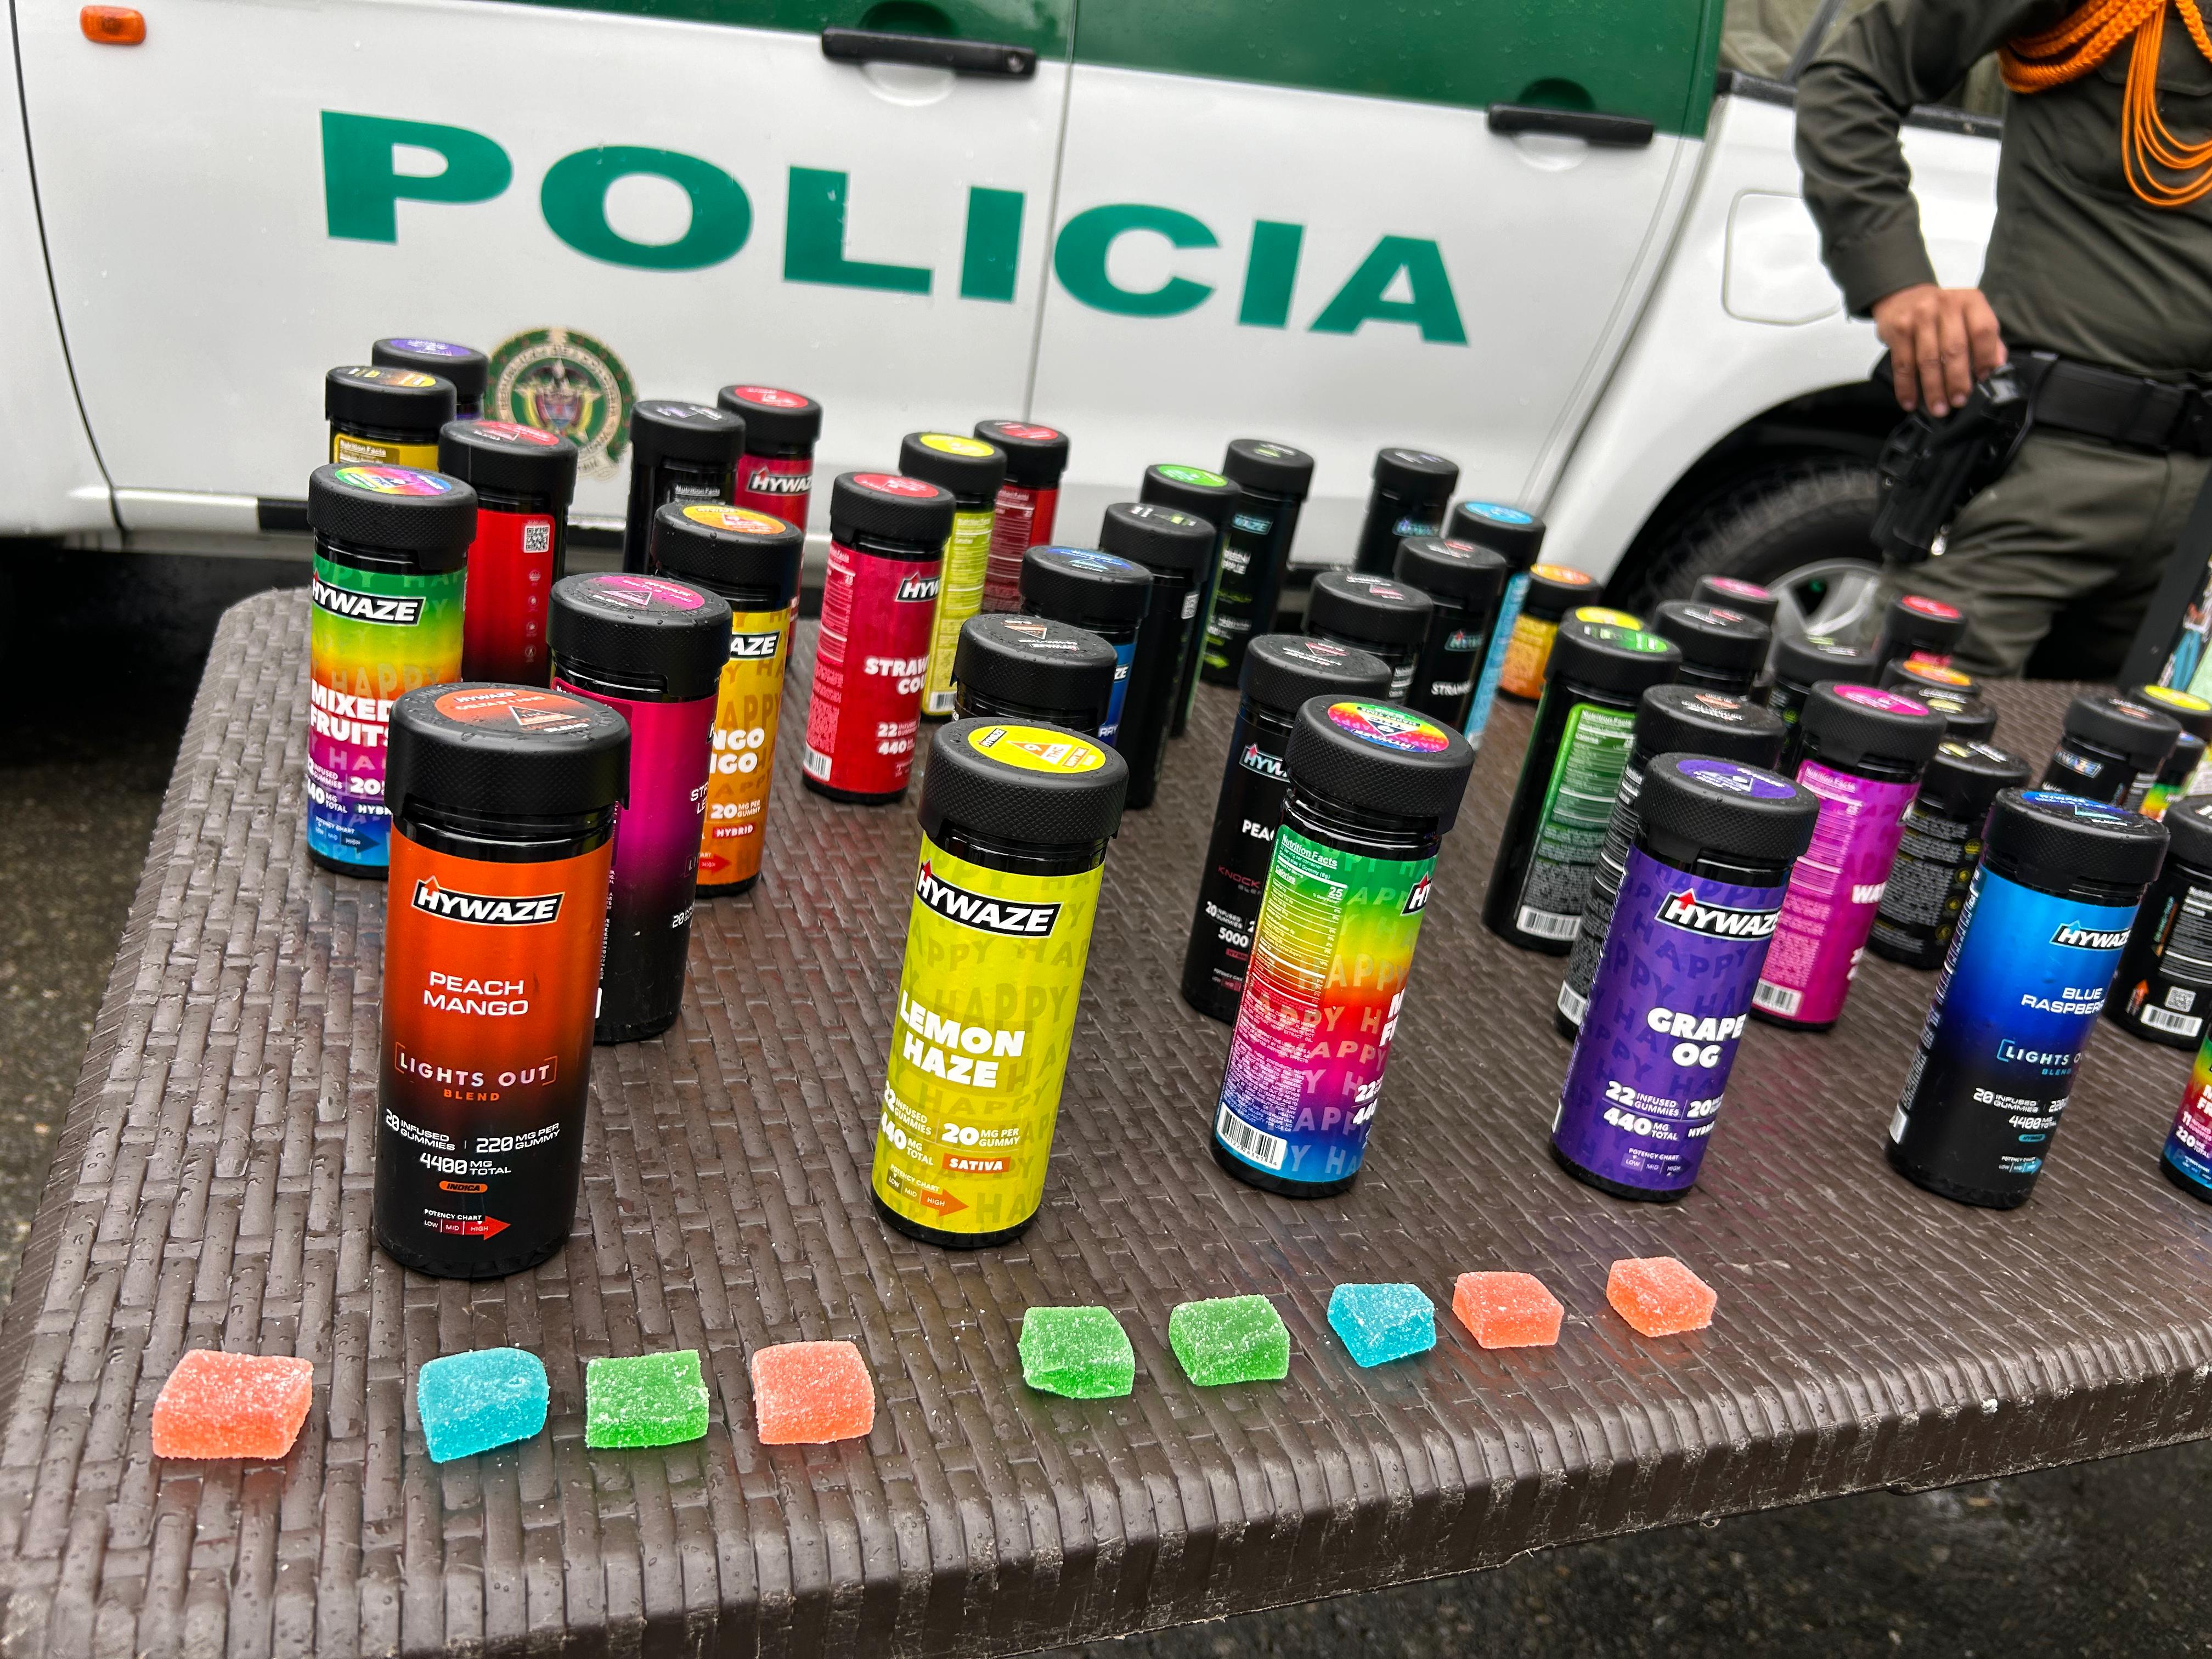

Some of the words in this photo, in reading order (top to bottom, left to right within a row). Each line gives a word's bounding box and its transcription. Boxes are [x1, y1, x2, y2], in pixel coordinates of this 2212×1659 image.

[321, 111, 1469, 346] POLICIA
[752, 474, 812, 493] HYWAZ
[901, 578, 940, 599] HYW
[312, 578, 418, 622] HYWAZE
[730, 636, 777, 657] AZE
[864, 657, 928, 678] STRAW
[312, 678, 394, 723] MIXED
[713, 727, 765, 752] NGO
[877, 721, 898, 738] 22
[877, 740, 907, 755] 440
[1243, 749, 1288, 778] HYW
[350, 776, 382, 795] 20
[710, 803, 737, 820] 20
[737, 803, 751, 811] MG
[736, 805, 761, 818] GUMMY
[716, 824, 754, 838] HYBRID
[1242, 819, 1274, 842] PEA
[1282, 833, 1312, 858] Nutrition
[1312, 850, 1338, 867] Facts
[918, 868, 1054, 932] HYWAZE
[1328, 885, 1344, 898] 25
[417, 885, 558, 921] HYWAZE
[1205, 900, 1217, 918] 20
[1218, 926, 1249, 947] 5000
[429, 970, 524, 996] PEACH
[2062, 987, 2103, 1000] BLUE
[423, 990, 529, 1016] MANGO
[2021, 994, 2104, 1015] RASPBER
[900, 989, 1025, 1058] LEMON
[1646, 1006, 1746, 1041] GRAPE
[903, 1031, 999, 1088] HAZE
[1672, 1042, 1723, 1069] OG
[2005, 1045, 2069, 1066] LIGHTS
[400, 1052, 484, 1087] LIGHTS
[498, 1064, 550, 1087] OUT
[443, 1088, 500, 1102] BLEND
[1355, 1081, 1376, 1103] 22
[1605, 1080, 1637, 1107] 22
[1636, 1092, 1678, 1109] INFUSED
[1687, 1098, 1712, 1118] 20
[1973, 1087, 1994, 1105] 20
[1995, 1094, 2037, 1108] INFUSED
[1634, 1101, 1680, 1119] GUMMIES
[1993, 1100, 2039, 1114] GUMMIES
[386, 1108, 399, 1131] 20
[400, 1119, 450, 1142] INFUSED
[476, 1136, 514, 1153] 220
[515, 1131, 536, 1142] MG
[538, 1122, 560, 1137] PER
[894, 1107, 932, 1136] GUMMIES
[978, 1135, 1020, 1147] GUMMY
[895, 1097, 928, 1125] INFUSED
[941, 1122, 979, 1147] 20
[980, 1129, 999, 1138] MG
[1000, 1127, 1020, 1137] PER
[1603, 1106, 1652, 1136] 440
[1653, 1122, 1669, 1132] MG
[2008, 1115, 2041, 1130] 4400
[400, 1128, 455, 1152] GUMMIES
[515, 1129, 560, 1150] GUMMY
[908, 1137, 923, 1152] MG
[1651, 1130, 1678, 1142] TOTAL
[419, 1152, 467, 1175] 4400
[906, 1146, 934, 1166] TOTAL
[949, 1158, 1003, 1171] SATIVA
[1628, 1148, 1658, 1160] POTENCY
[1658, 1154, 1680, 1162] CHART
[470, 1166, 512, 1176] TOTAL
[890, 1164, 916, 1185] POTENCY
[916, 1177, 940, 1193] CHART
[446, 1183, 481, 1192] INDICA
[889, 1176, 900, 1189] LOW
[904, 1187, 918, 1198] MID
[927, 1197, 946, 1207] HIGH
[424, 1209, 456, 1220] POTENCY
[424, 1220, 438, 1228] LOW
